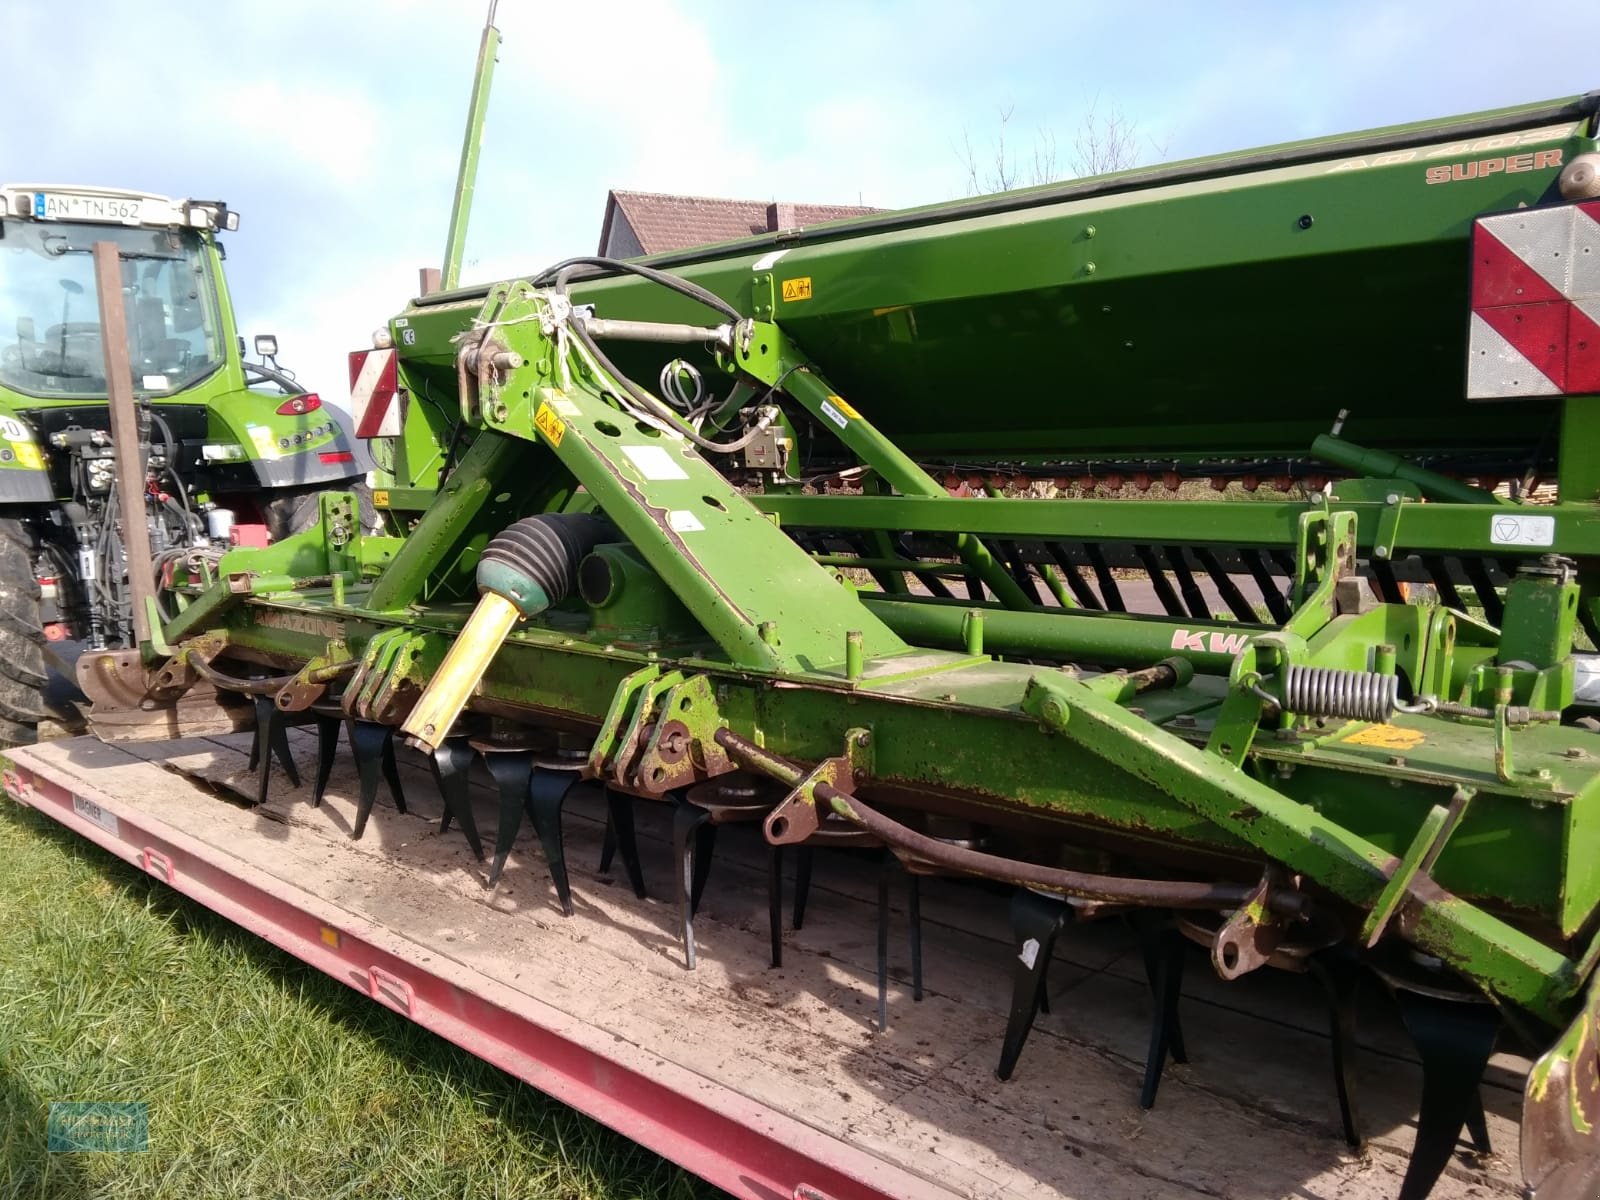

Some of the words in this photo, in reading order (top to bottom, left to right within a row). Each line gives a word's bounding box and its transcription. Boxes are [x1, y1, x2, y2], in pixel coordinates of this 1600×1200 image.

[1425, 149, 1563, 185] SUPER
[47, 197, 70, 215] AN
[82, 199, 104, 217] TN
[108, 201, 140, 219] 562
[253, 608, 346, 639] AMAZONE
[1171, 629, 1248, 655] KW
